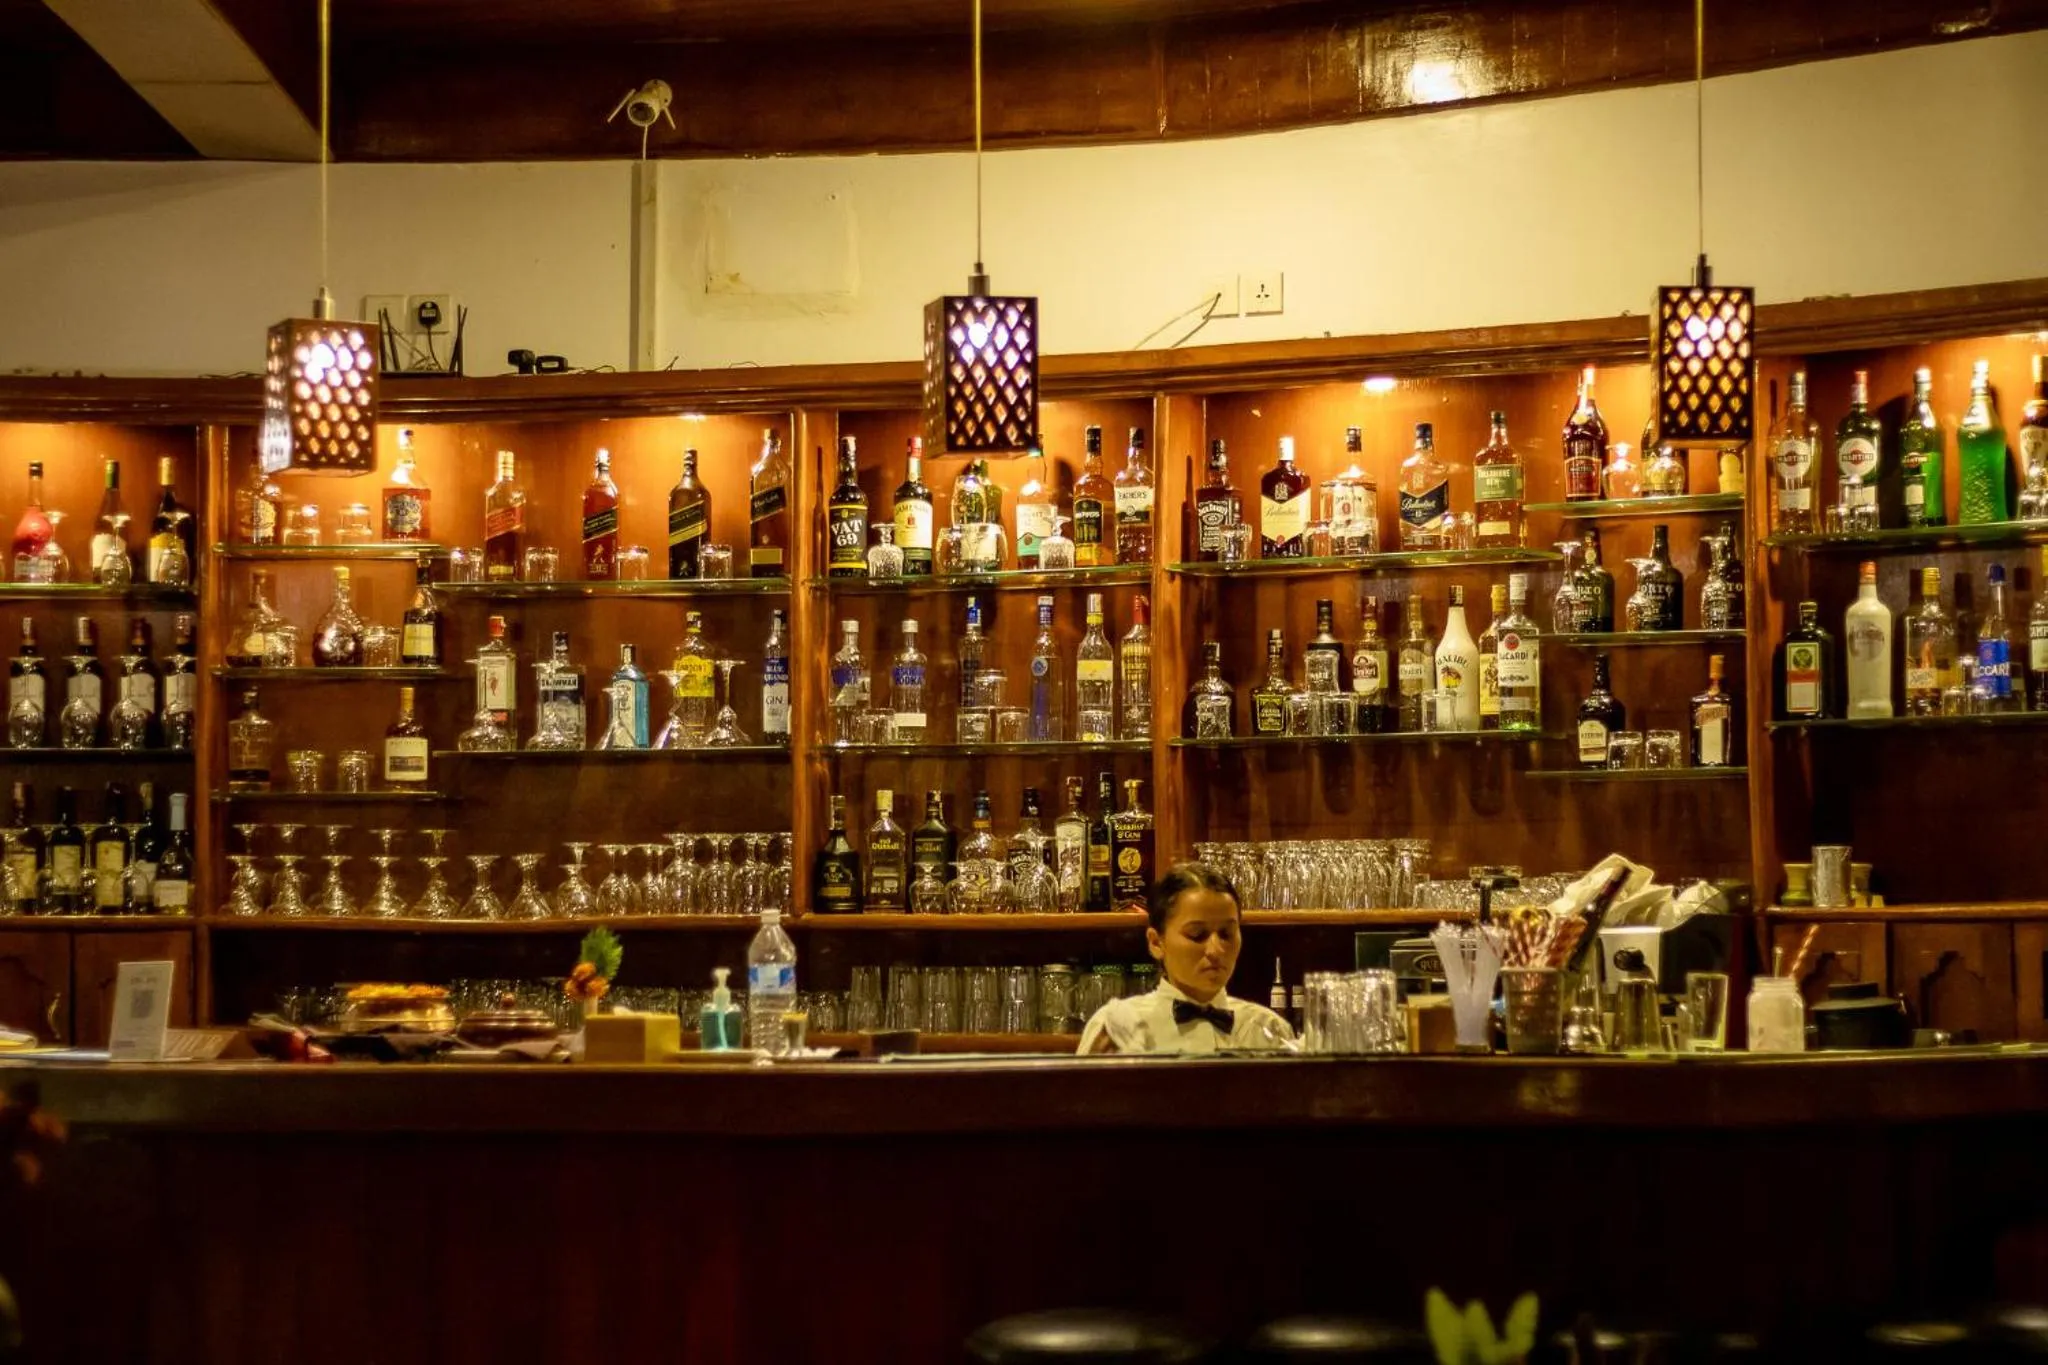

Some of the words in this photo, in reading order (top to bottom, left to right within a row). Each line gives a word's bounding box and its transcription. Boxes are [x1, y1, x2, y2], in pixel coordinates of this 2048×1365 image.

[831, 519, 863, 536] VAT
[836, 533, 859, 546] 69
[1640, 582, 1674, 595] ORTO
[766, 695, 784, 705] GIN
